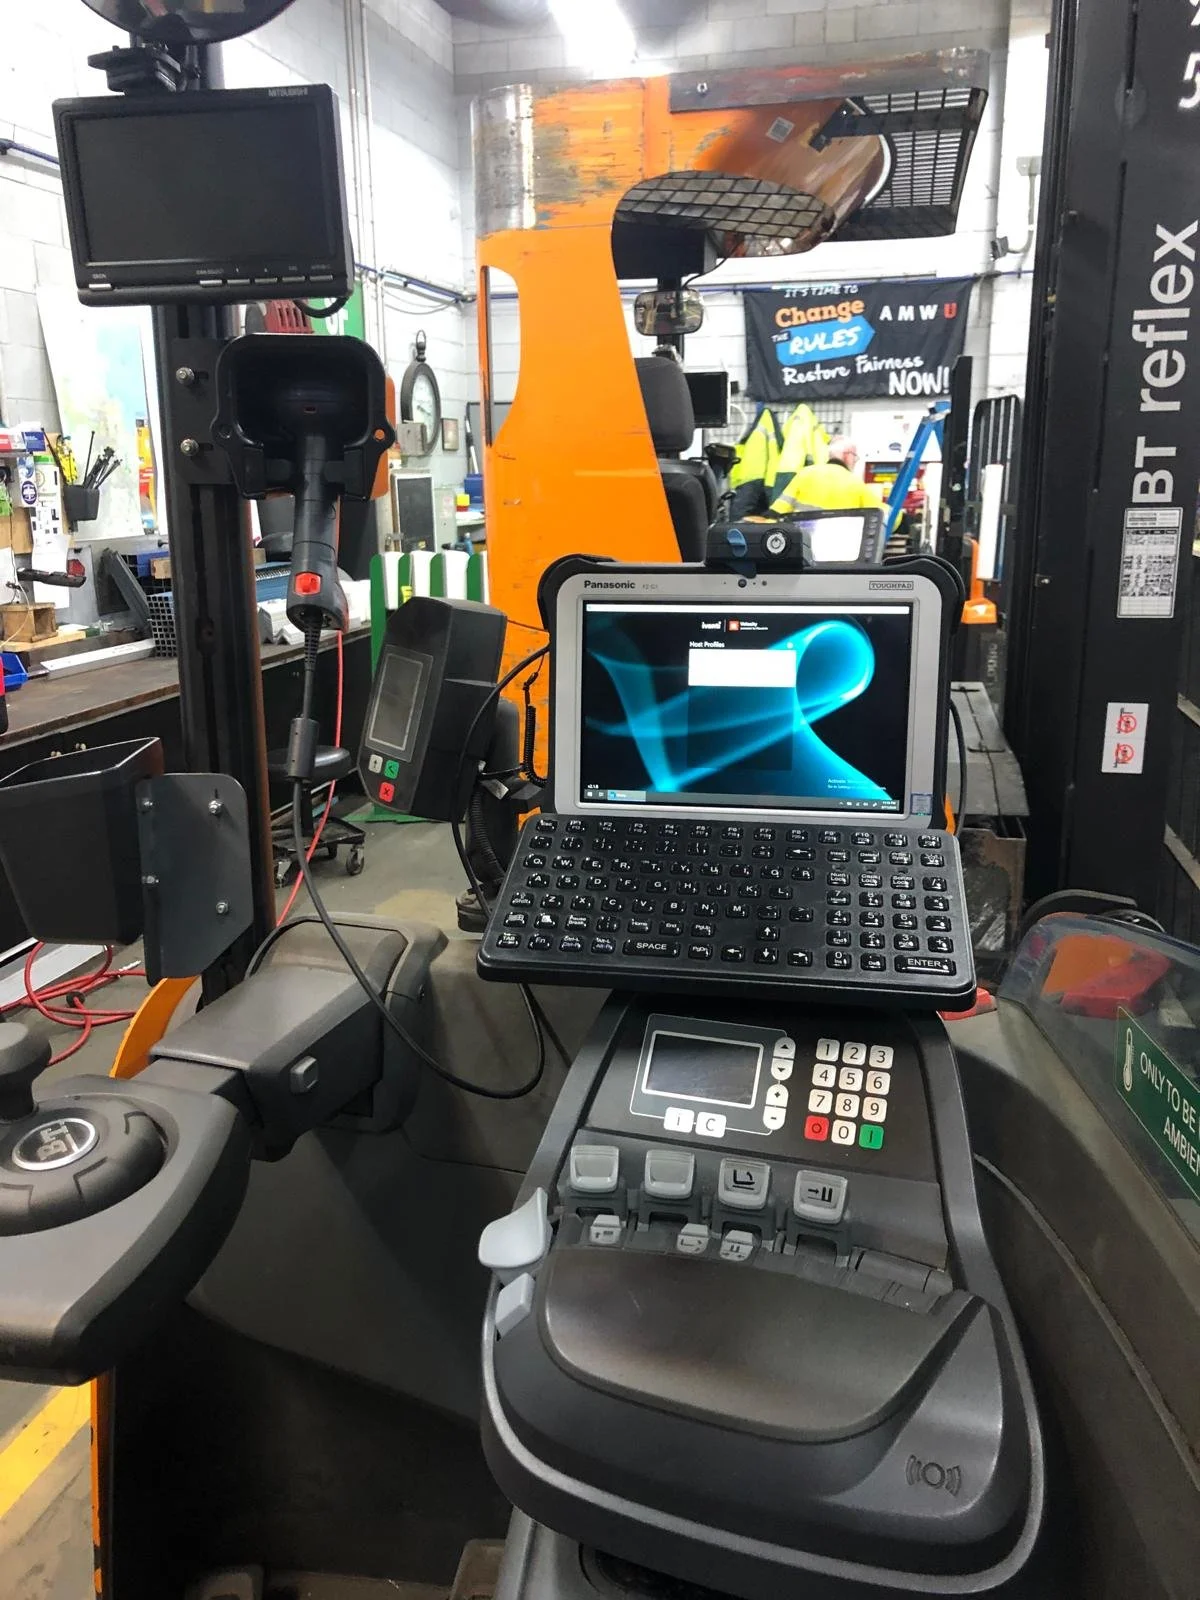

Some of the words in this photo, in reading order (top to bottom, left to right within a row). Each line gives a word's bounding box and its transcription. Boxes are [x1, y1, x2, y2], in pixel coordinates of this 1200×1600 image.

[784, 287, 808, 298] IT'S
[812, 285, 840, 296] TIME
[844, 285, 858, 295] TO
[775, 299, 865, 328] Change
[1132, 219, 1199, 412] reflex
[771, 333, 789, 343] THE
[789, 326, 862, 356] RULES
[781, 363, 850, 386] Restore
[855, 354, 924, 375] Fairness
[889, 366, 950, 396] NOW!
[1132, 436, 1177, 503] BT
[584, 580, 636, 589] Panasonic
[704, 641, 725, 649] Profiles
[636, 942, 667, 950] SPACE
[908, 959, 941, 967] ENTER
[850, 1047, 858, 1060] 2
[877, 1050, 885, 1063] 3
[819, 1069, 828, 1082] 4
[847, 1072, 855, 1085] 5
[874, 1076, 882, 1089] 6
[1140, 1052, 1165, 1094] ONLY
[1165, 1079, 1180, 1112] TO
[1182, 1098, 1196, 1133] BE
[816, 1095, 825, 1107] 7
[843, 1099, 852, 1112] 8
[870, 1102, 879, 1116] 9
[706, 1118, 716, 1132] C
